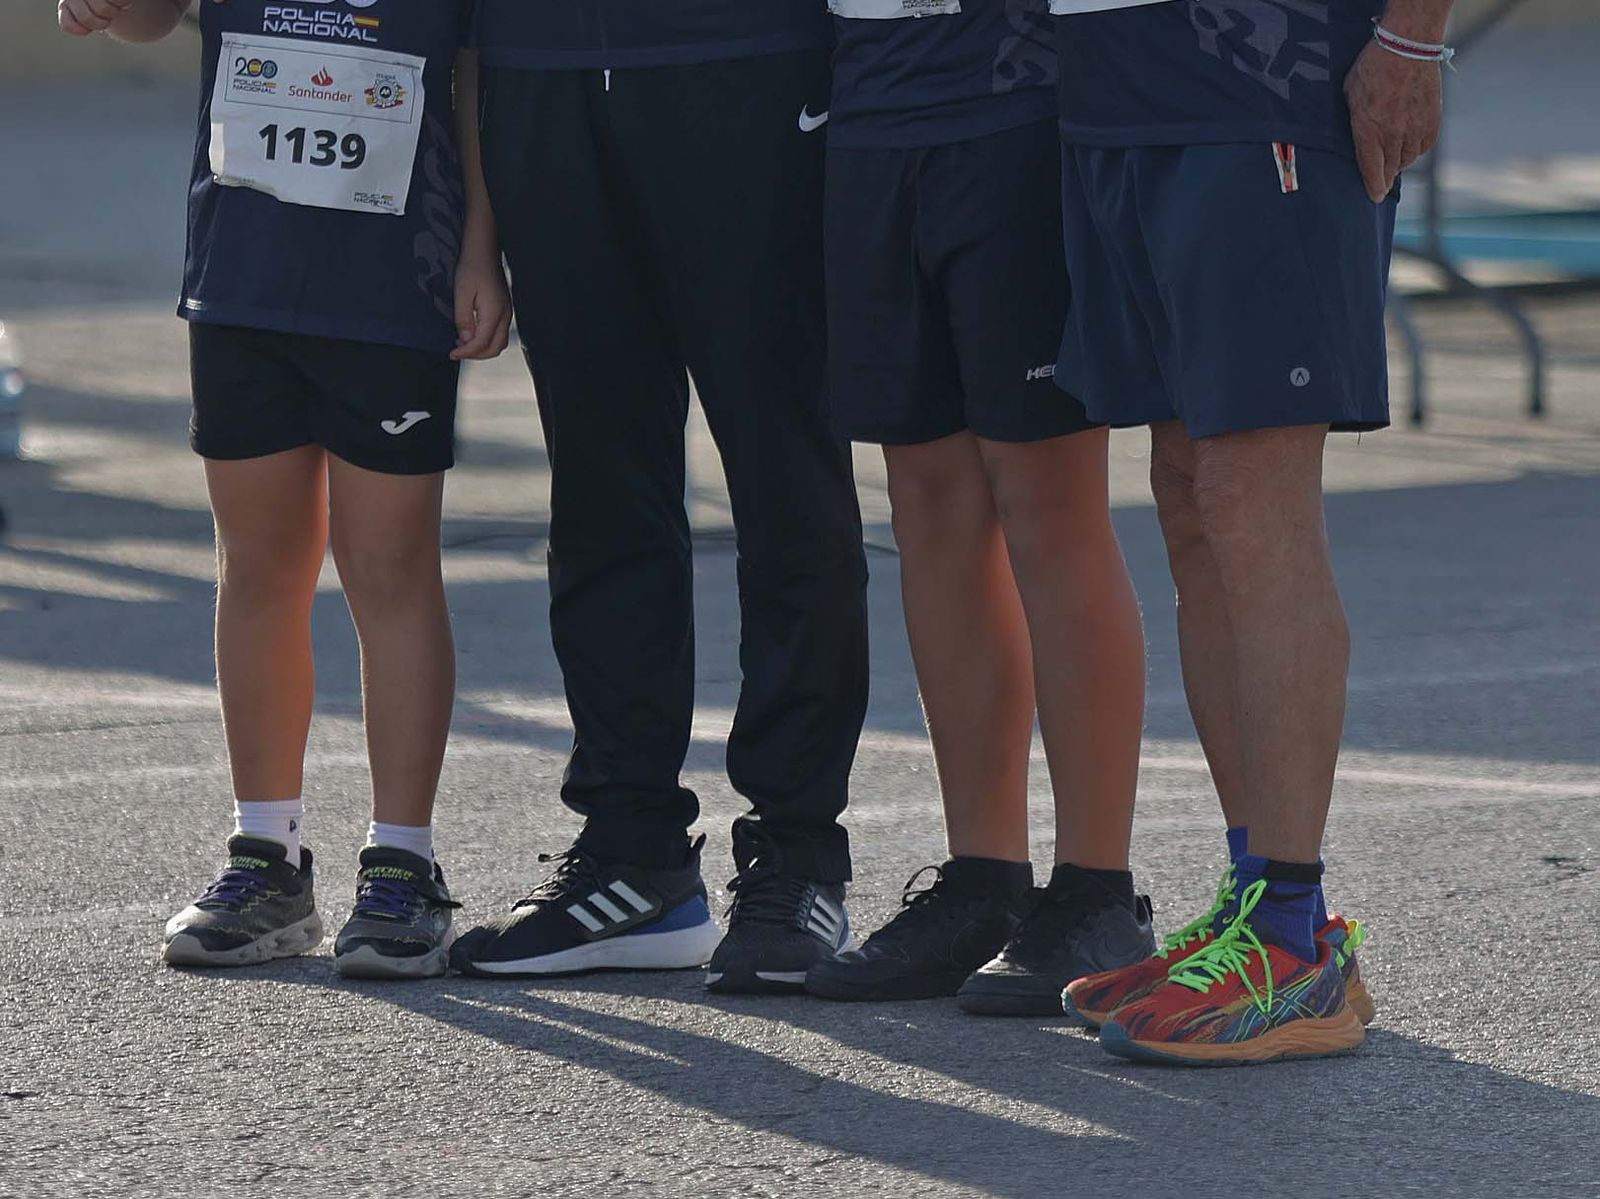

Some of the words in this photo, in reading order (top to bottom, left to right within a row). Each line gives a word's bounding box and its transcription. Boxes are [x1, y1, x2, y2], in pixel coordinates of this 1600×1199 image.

[263, 6, 356, 26] POLICIA
[262, 21, 378, 43] NACIONAL
[234, 56, 278, 79] 200
[288, 85, 352, 103] Santander
[258, 123, 366, 170] 1139
